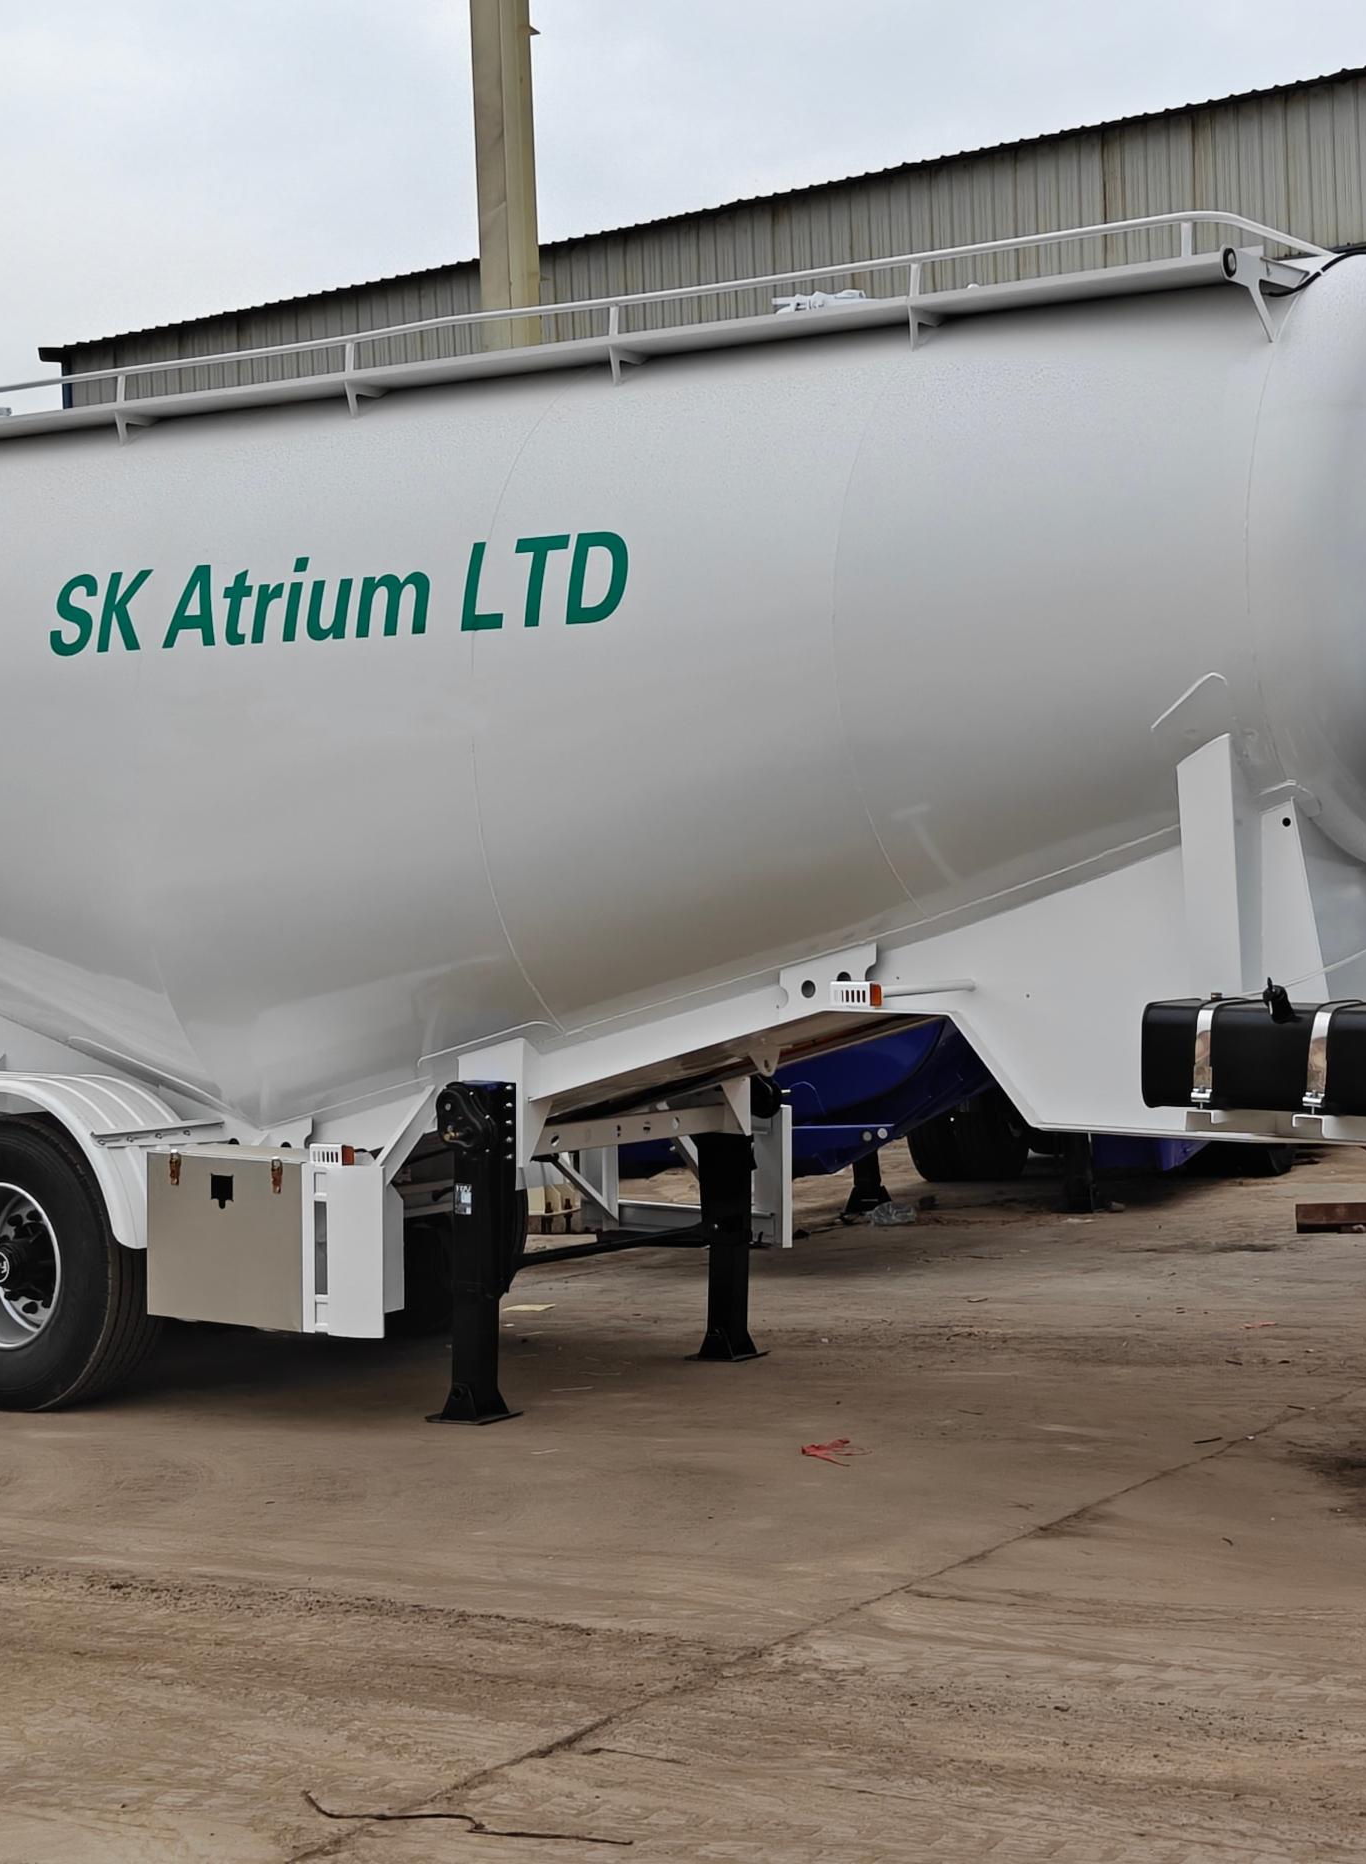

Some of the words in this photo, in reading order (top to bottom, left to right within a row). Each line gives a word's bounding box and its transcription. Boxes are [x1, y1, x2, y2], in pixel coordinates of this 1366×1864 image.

[49, 568, 153, 657] SK
[162, 556, 431, 649] Atrium
[460, 531, 629, 632] LTD
